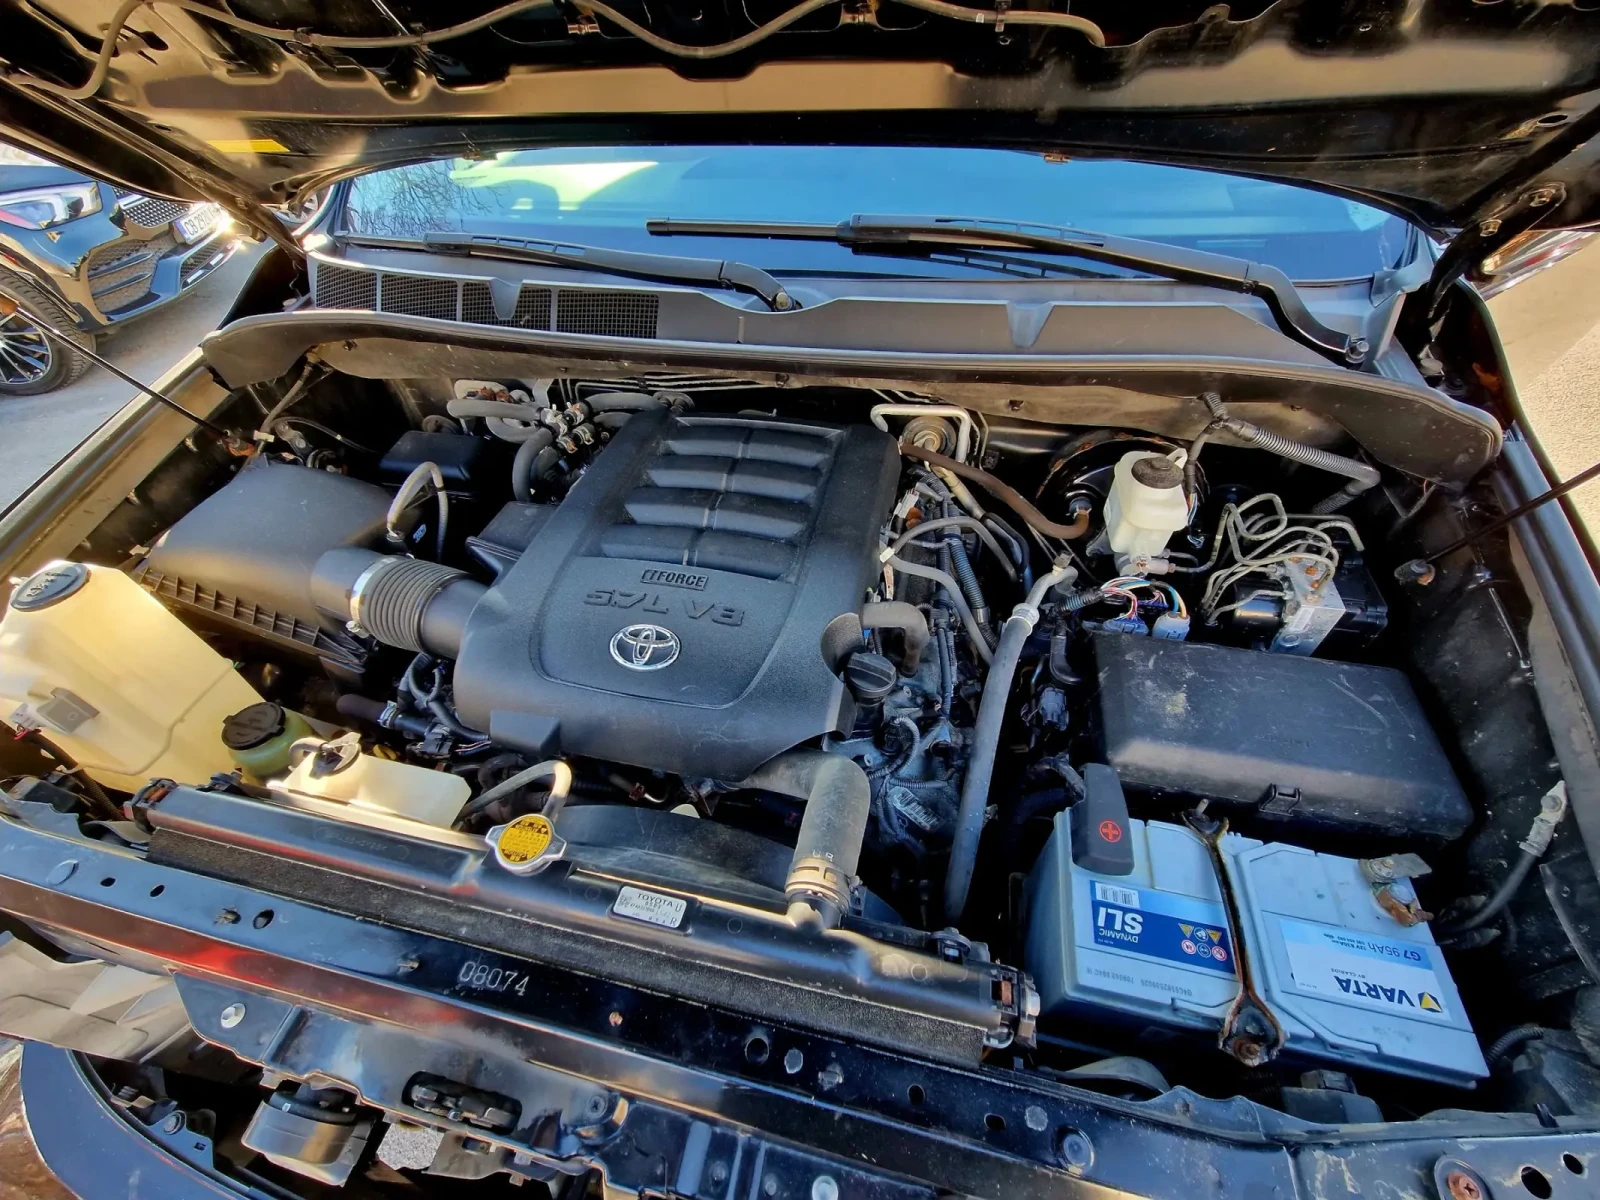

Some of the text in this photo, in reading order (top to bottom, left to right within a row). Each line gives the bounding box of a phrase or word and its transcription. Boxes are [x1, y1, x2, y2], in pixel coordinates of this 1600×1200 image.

[683, 600, 745, 627] V8
[637, 893, 673, 907] TOYOTA
[1097, 906, 1144, 935] SLI
[1098, 928, 1139, 944] DYNAMIC
[1367, 942, 1422, 961] G7 95Ah
[459, 961, 530, 997] 08074
[1334, 975, 1415, 1008] VARTA
